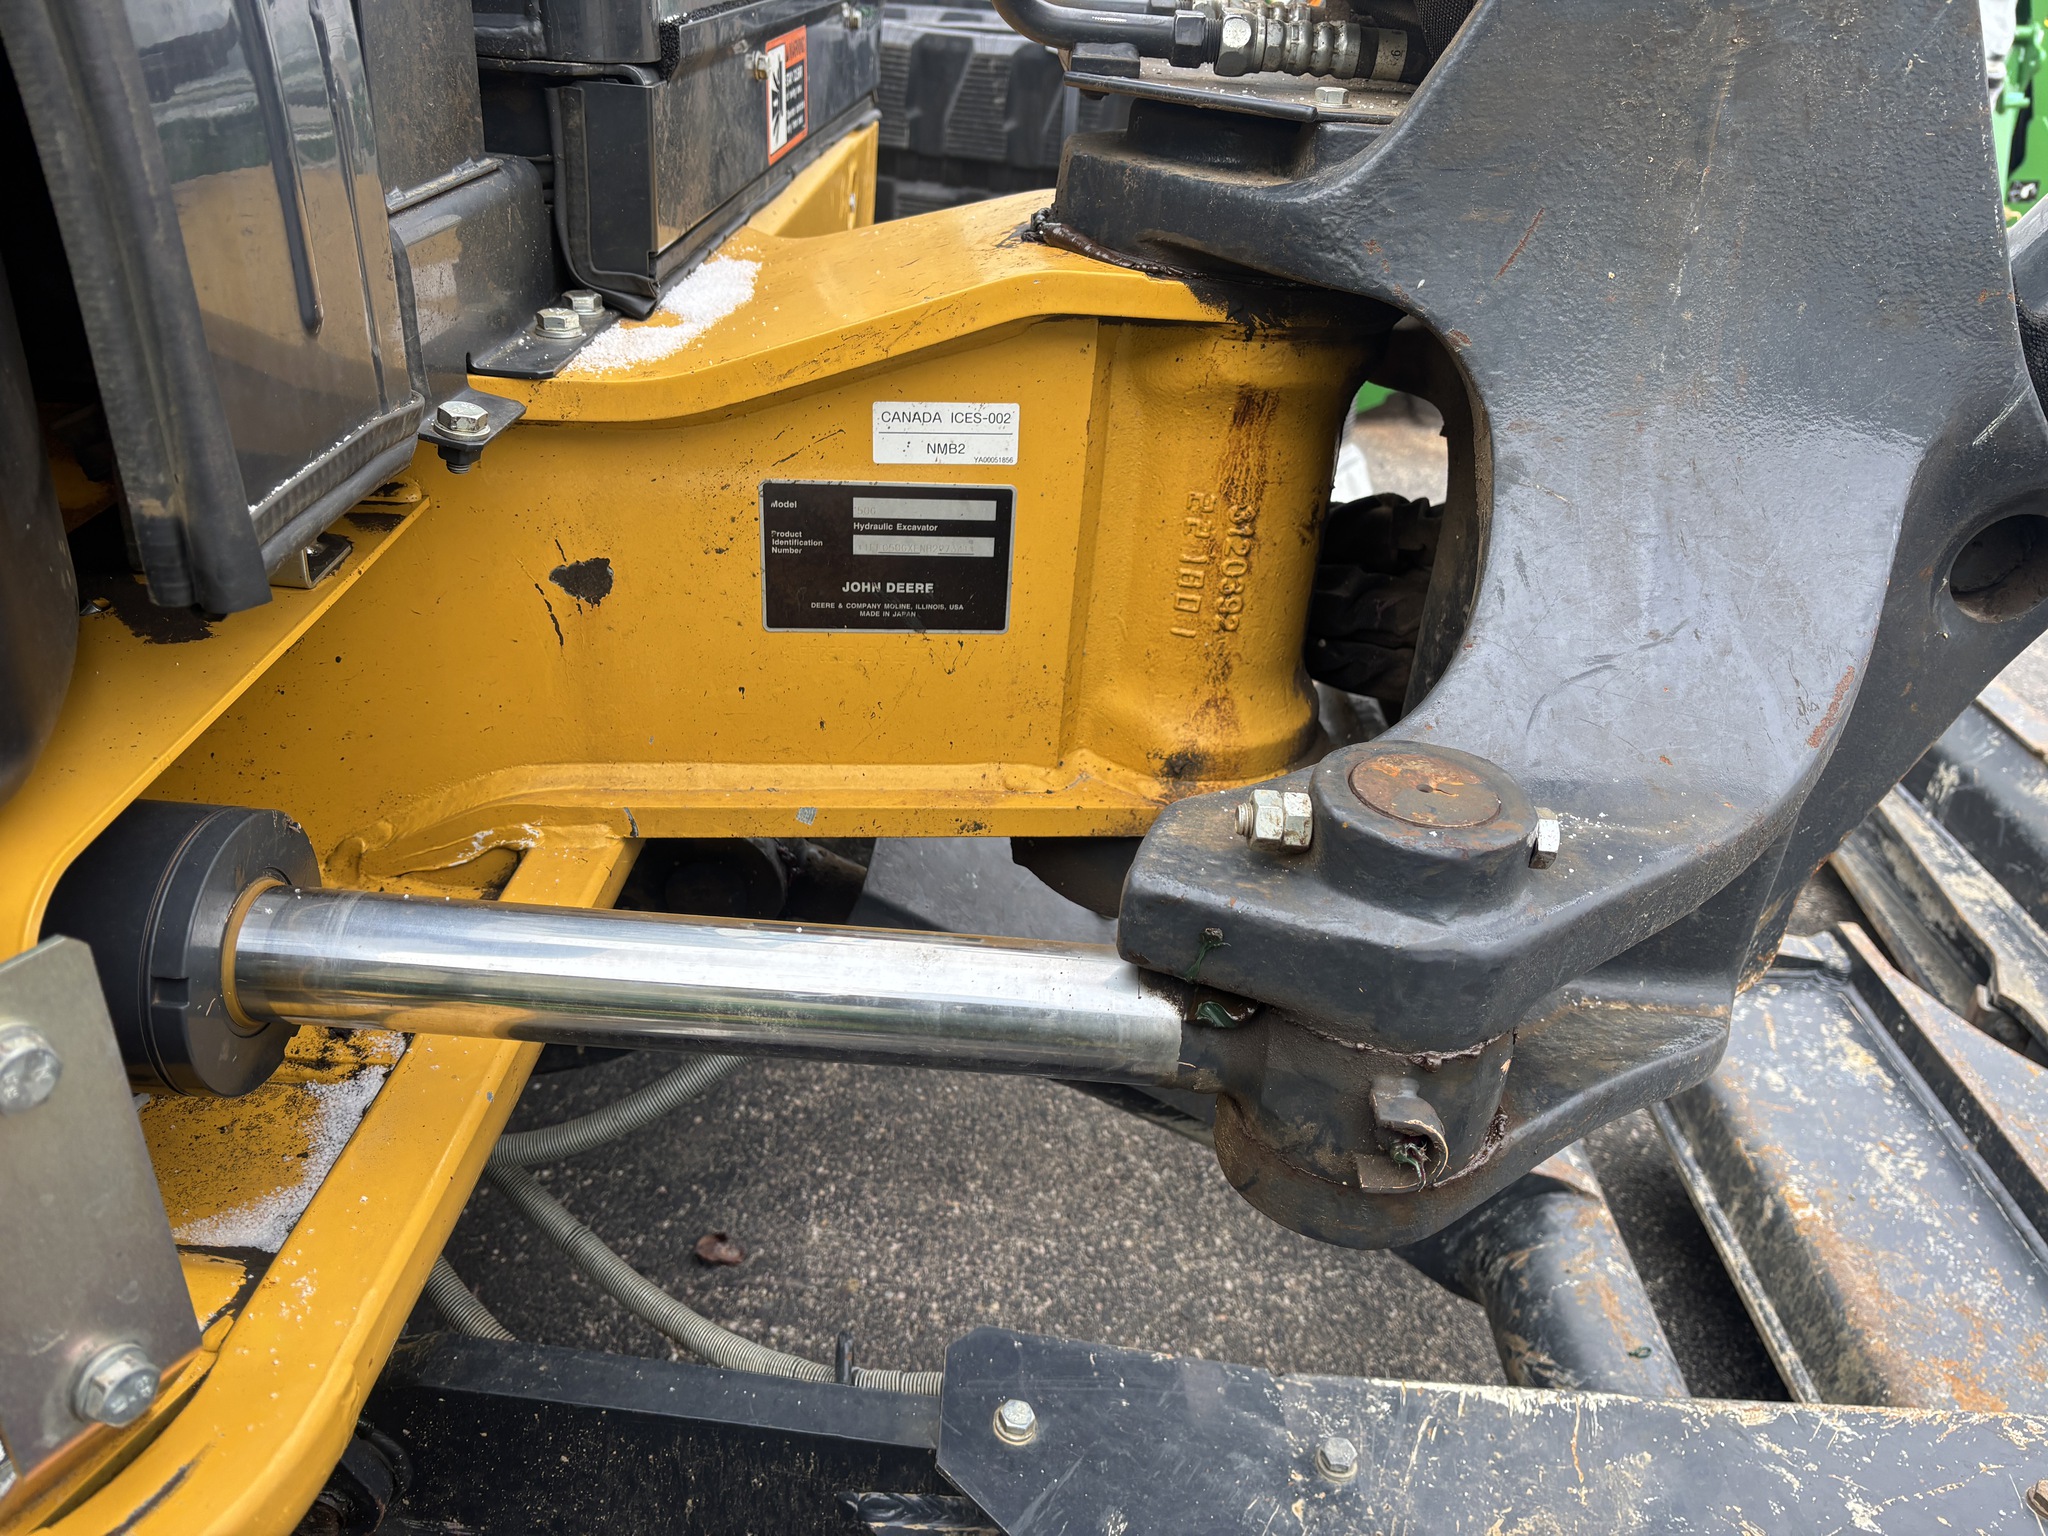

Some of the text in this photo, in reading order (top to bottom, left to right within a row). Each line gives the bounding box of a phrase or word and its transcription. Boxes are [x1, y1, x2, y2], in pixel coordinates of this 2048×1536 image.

[881, 411, 1011, 424] CANADA ICES-002
[927, 443, 966, 455] NMB2
[771, 500, 797, 508] Model
[853, 522, 939, 532] Hydraulic Excavator
[771, 530, 802, 538] Product
[771, 538, 823, 547] Identification
[771, 546, 802, 554] Number
[842, 581, 934, 593] JOHN DEERE
[846, 602, 882, 610] COMPANY
[884, 603, 913, 611] MOLINE,
[915, 603, 947, 611] ILLINOIS,
